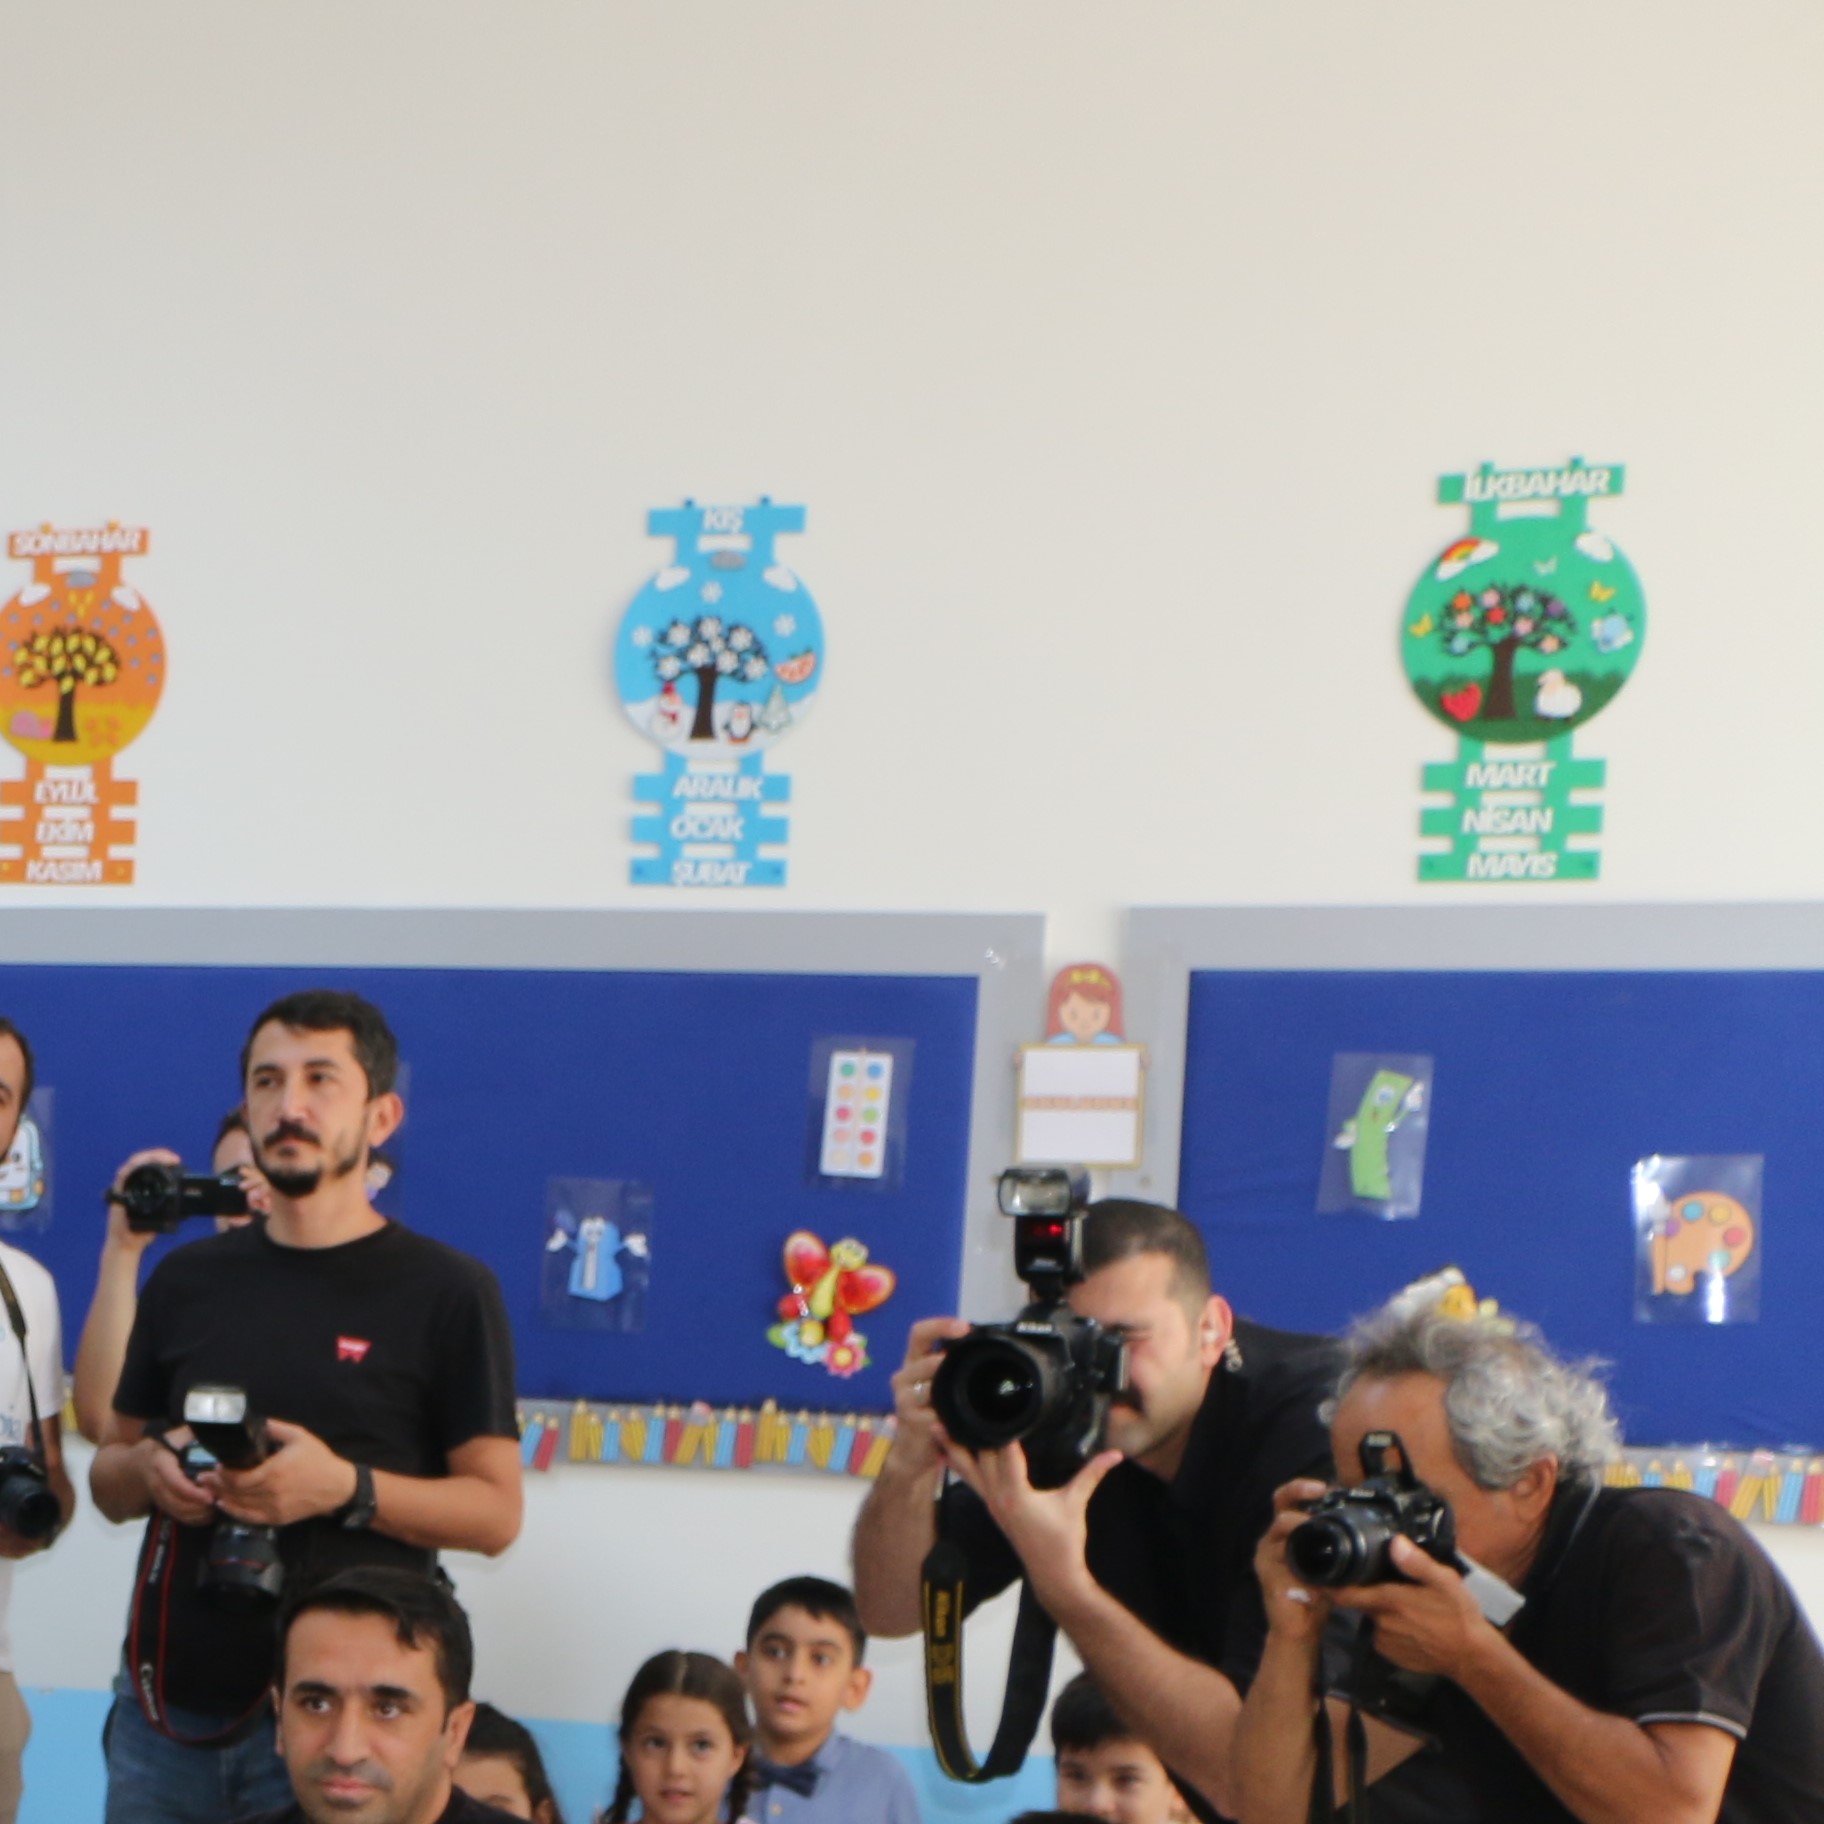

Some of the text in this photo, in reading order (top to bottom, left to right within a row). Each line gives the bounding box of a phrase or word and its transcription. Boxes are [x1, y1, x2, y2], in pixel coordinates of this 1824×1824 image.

[1463, 467, 1611, 502] İLKBAHAR
[702, 507, 744, 535] KIŞ
[15, 528, 142, 555] SONBAHAR
[673, 774, 763, 801] ARALIK
[1465, 760, 1556, 788] MART
[34, 775, 101, 804] EYLÜL
[35, 815, 95, 844] EKİM
[670, 816, 745, 842] OCAK
[1462, 803, 1553, 835] NİSAN
[26, 859, 104, 884] KASIM
[671, 861, 752, 887] ŞUBAT
[1465, 852, 1559, 880] MAYIS
